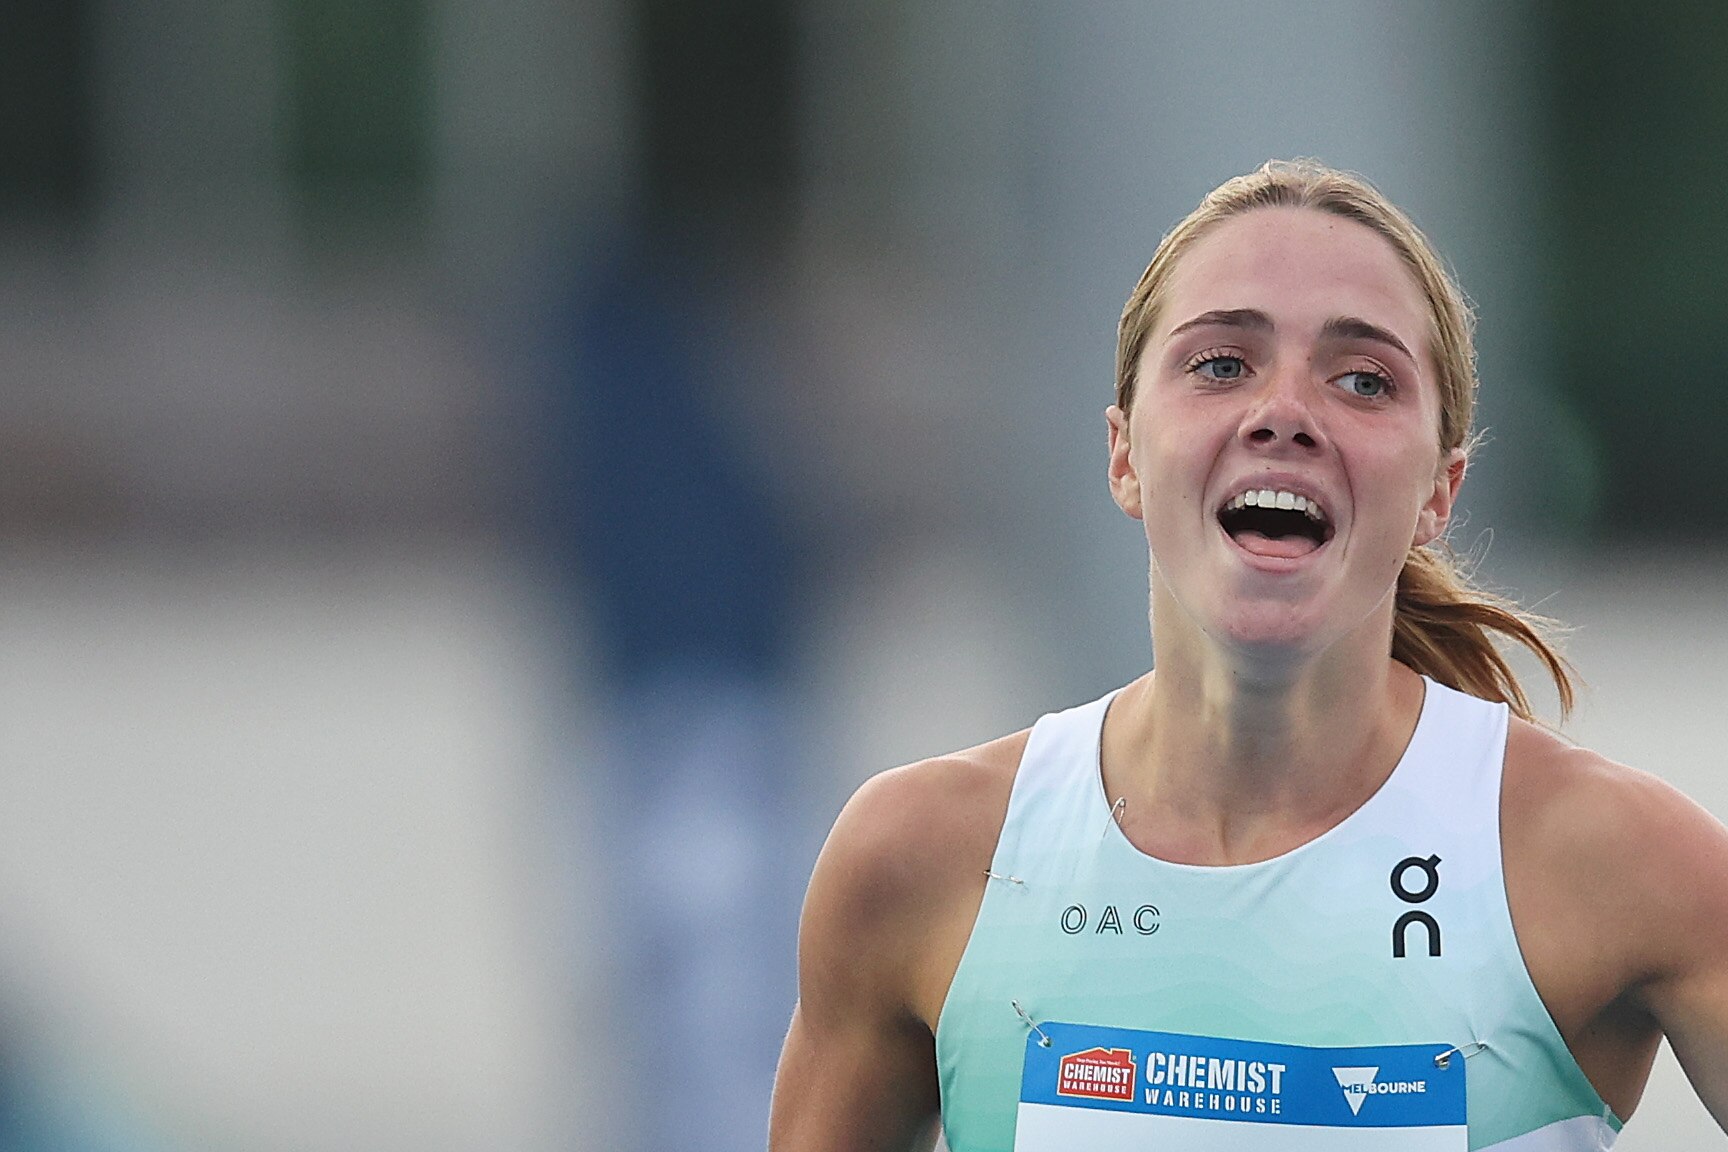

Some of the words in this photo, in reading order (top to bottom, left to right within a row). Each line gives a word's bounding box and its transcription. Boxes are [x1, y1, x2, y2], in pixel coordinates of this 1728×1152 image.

[1060, 902, 1161, 936] OAC
[1062, 1079, 1128, 1095] WAREHOUSE
[1063, 1062, 1131, 1085] CHEMIST
[1145, 1052, 1286, 1095] CHEMIST
[1144, 1087, 1282, 1115] WAREHOUSE
